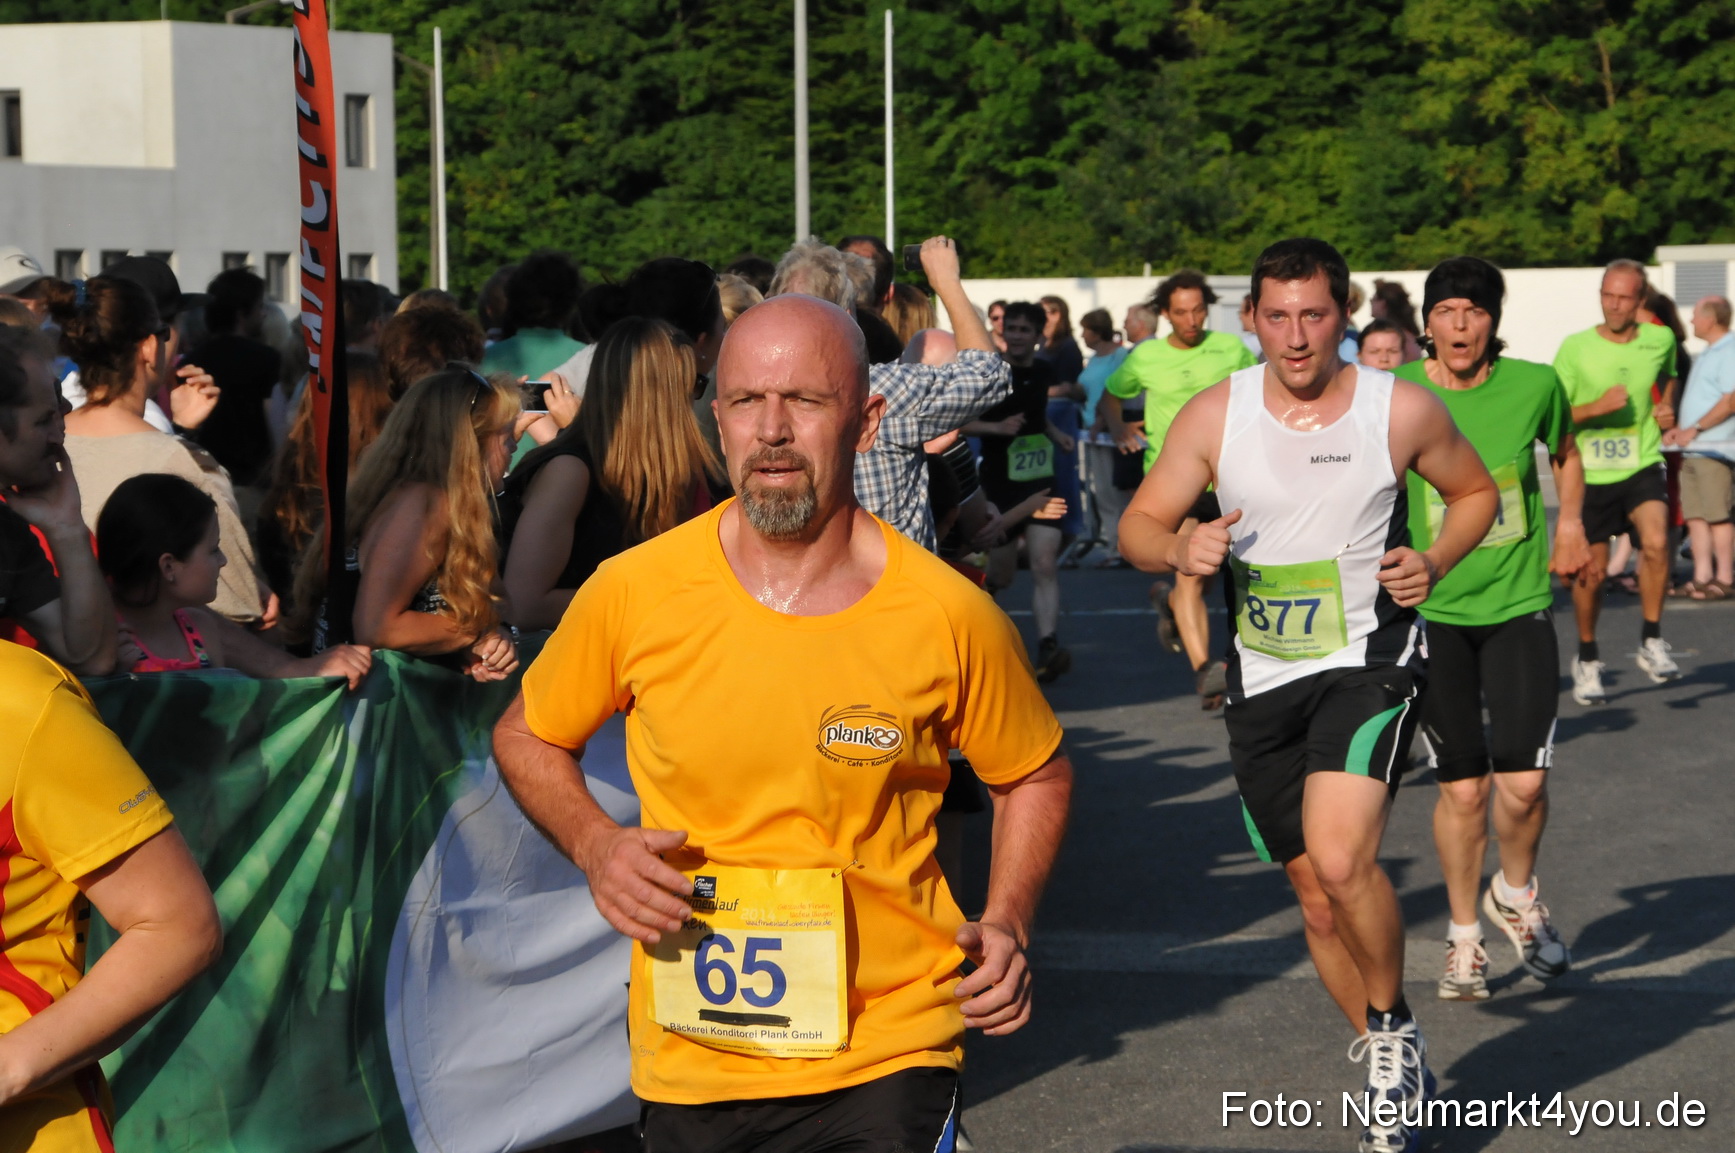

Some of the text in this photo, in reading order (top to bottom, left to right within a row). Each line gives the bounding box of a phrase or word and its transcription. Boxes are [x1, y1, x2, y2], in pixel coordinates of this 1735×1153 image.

[1015, 449, 1047, 471] 270
[1310, 453, 1351, 464] Michael
[1591, 439, 1630, 459] 193
[1246, 595, 1322, 636] 877
[826, 722, 879, 748] plank
[815, 743, 904, 768] Bäckerei Café Konditorei
[740, 907, 777, 921] 2014
[694, 933, 787, 1008] 65
[669, 1021, 823, 1040] Bäckerei Konditorei Plank GmbH
